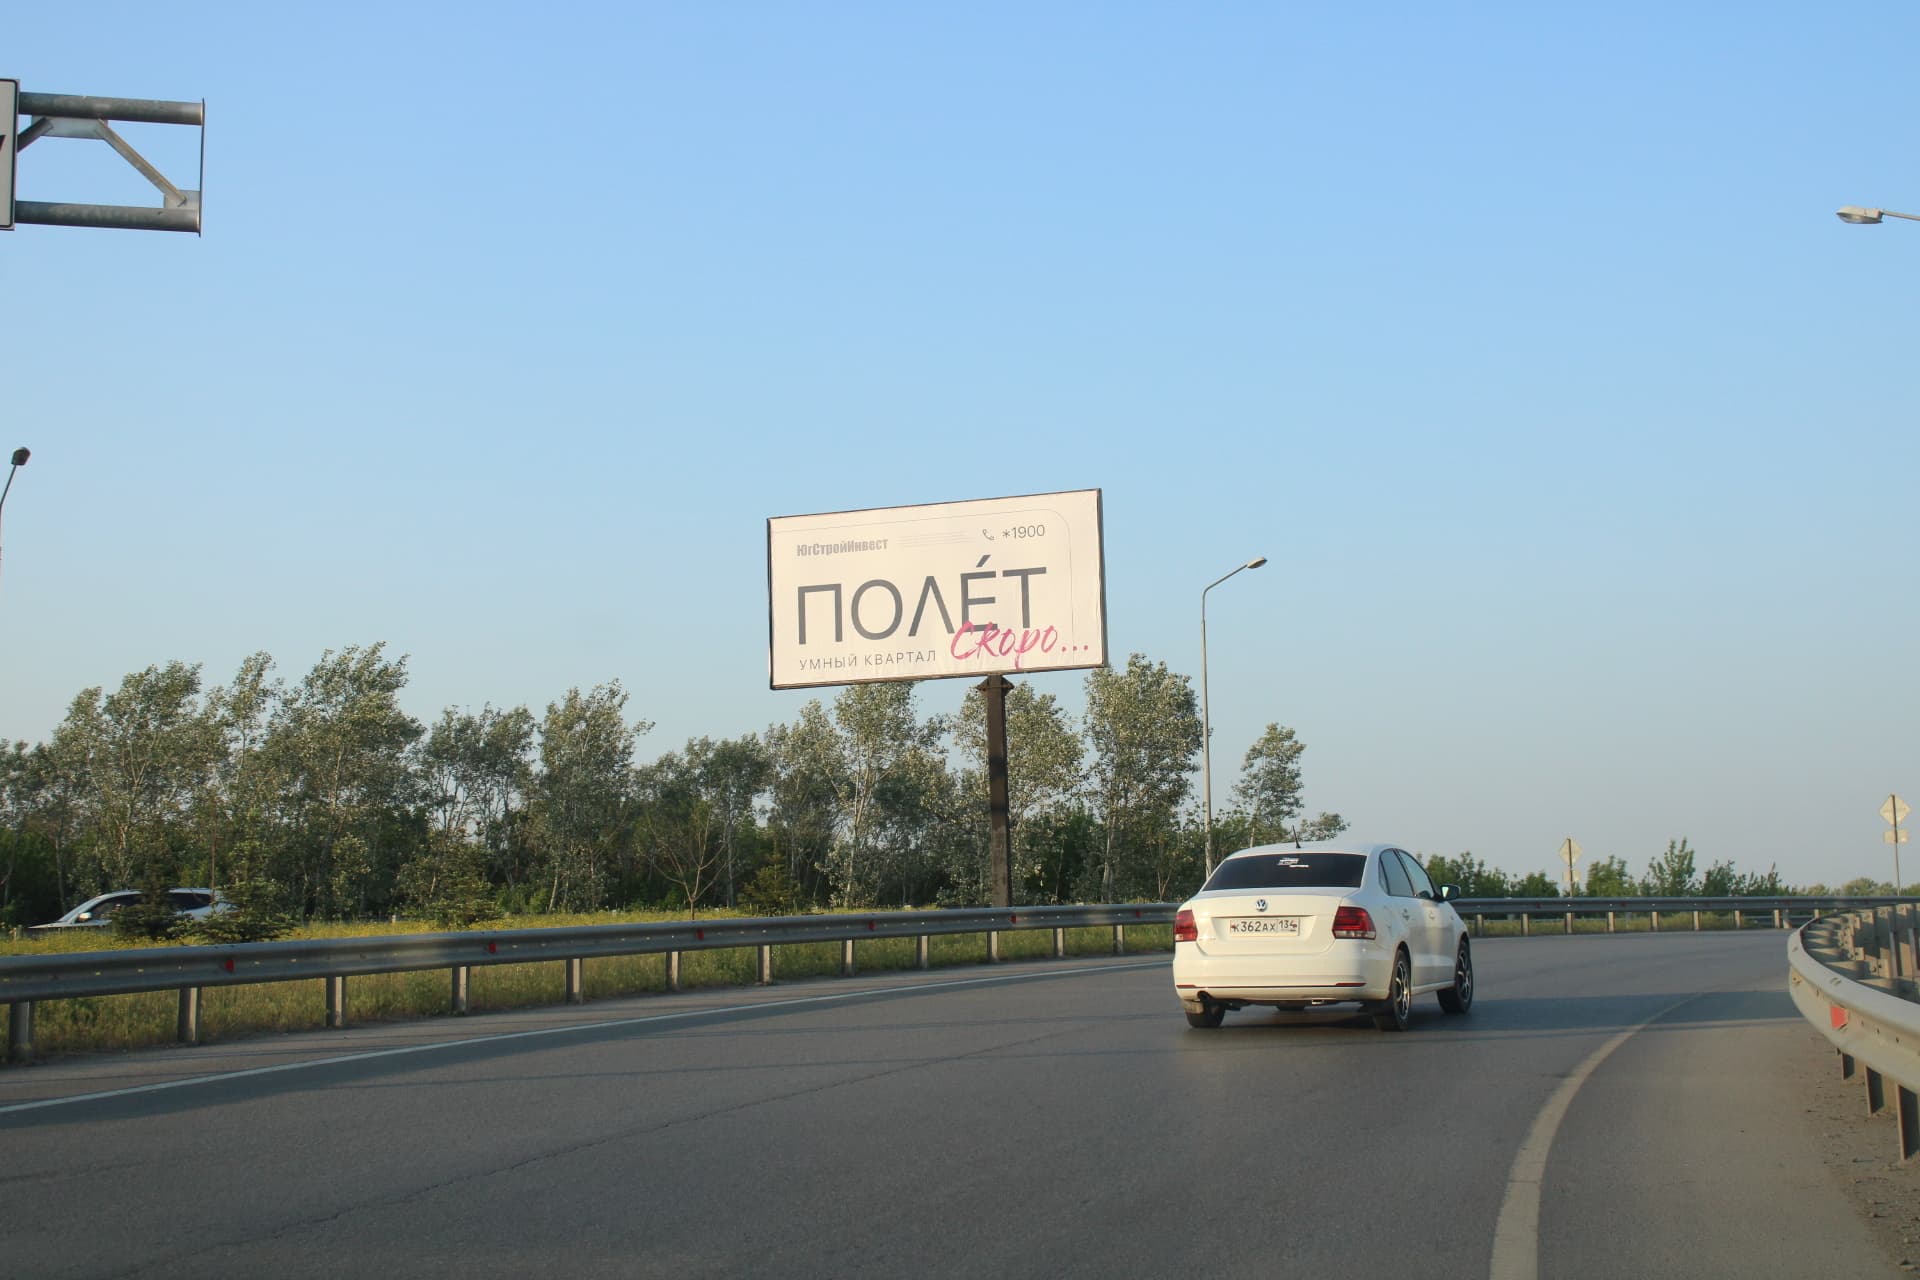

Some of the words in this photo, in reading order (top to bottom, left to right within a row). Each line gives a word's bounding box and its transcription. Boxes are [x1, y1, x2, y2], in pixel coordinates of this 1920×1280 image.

[797, 539, 888, 556] ЮгСтройИнвест
[800, 654, 857, 670] УМНЫЙ
[864, 650, 936, 666] КВАРТАЛ
